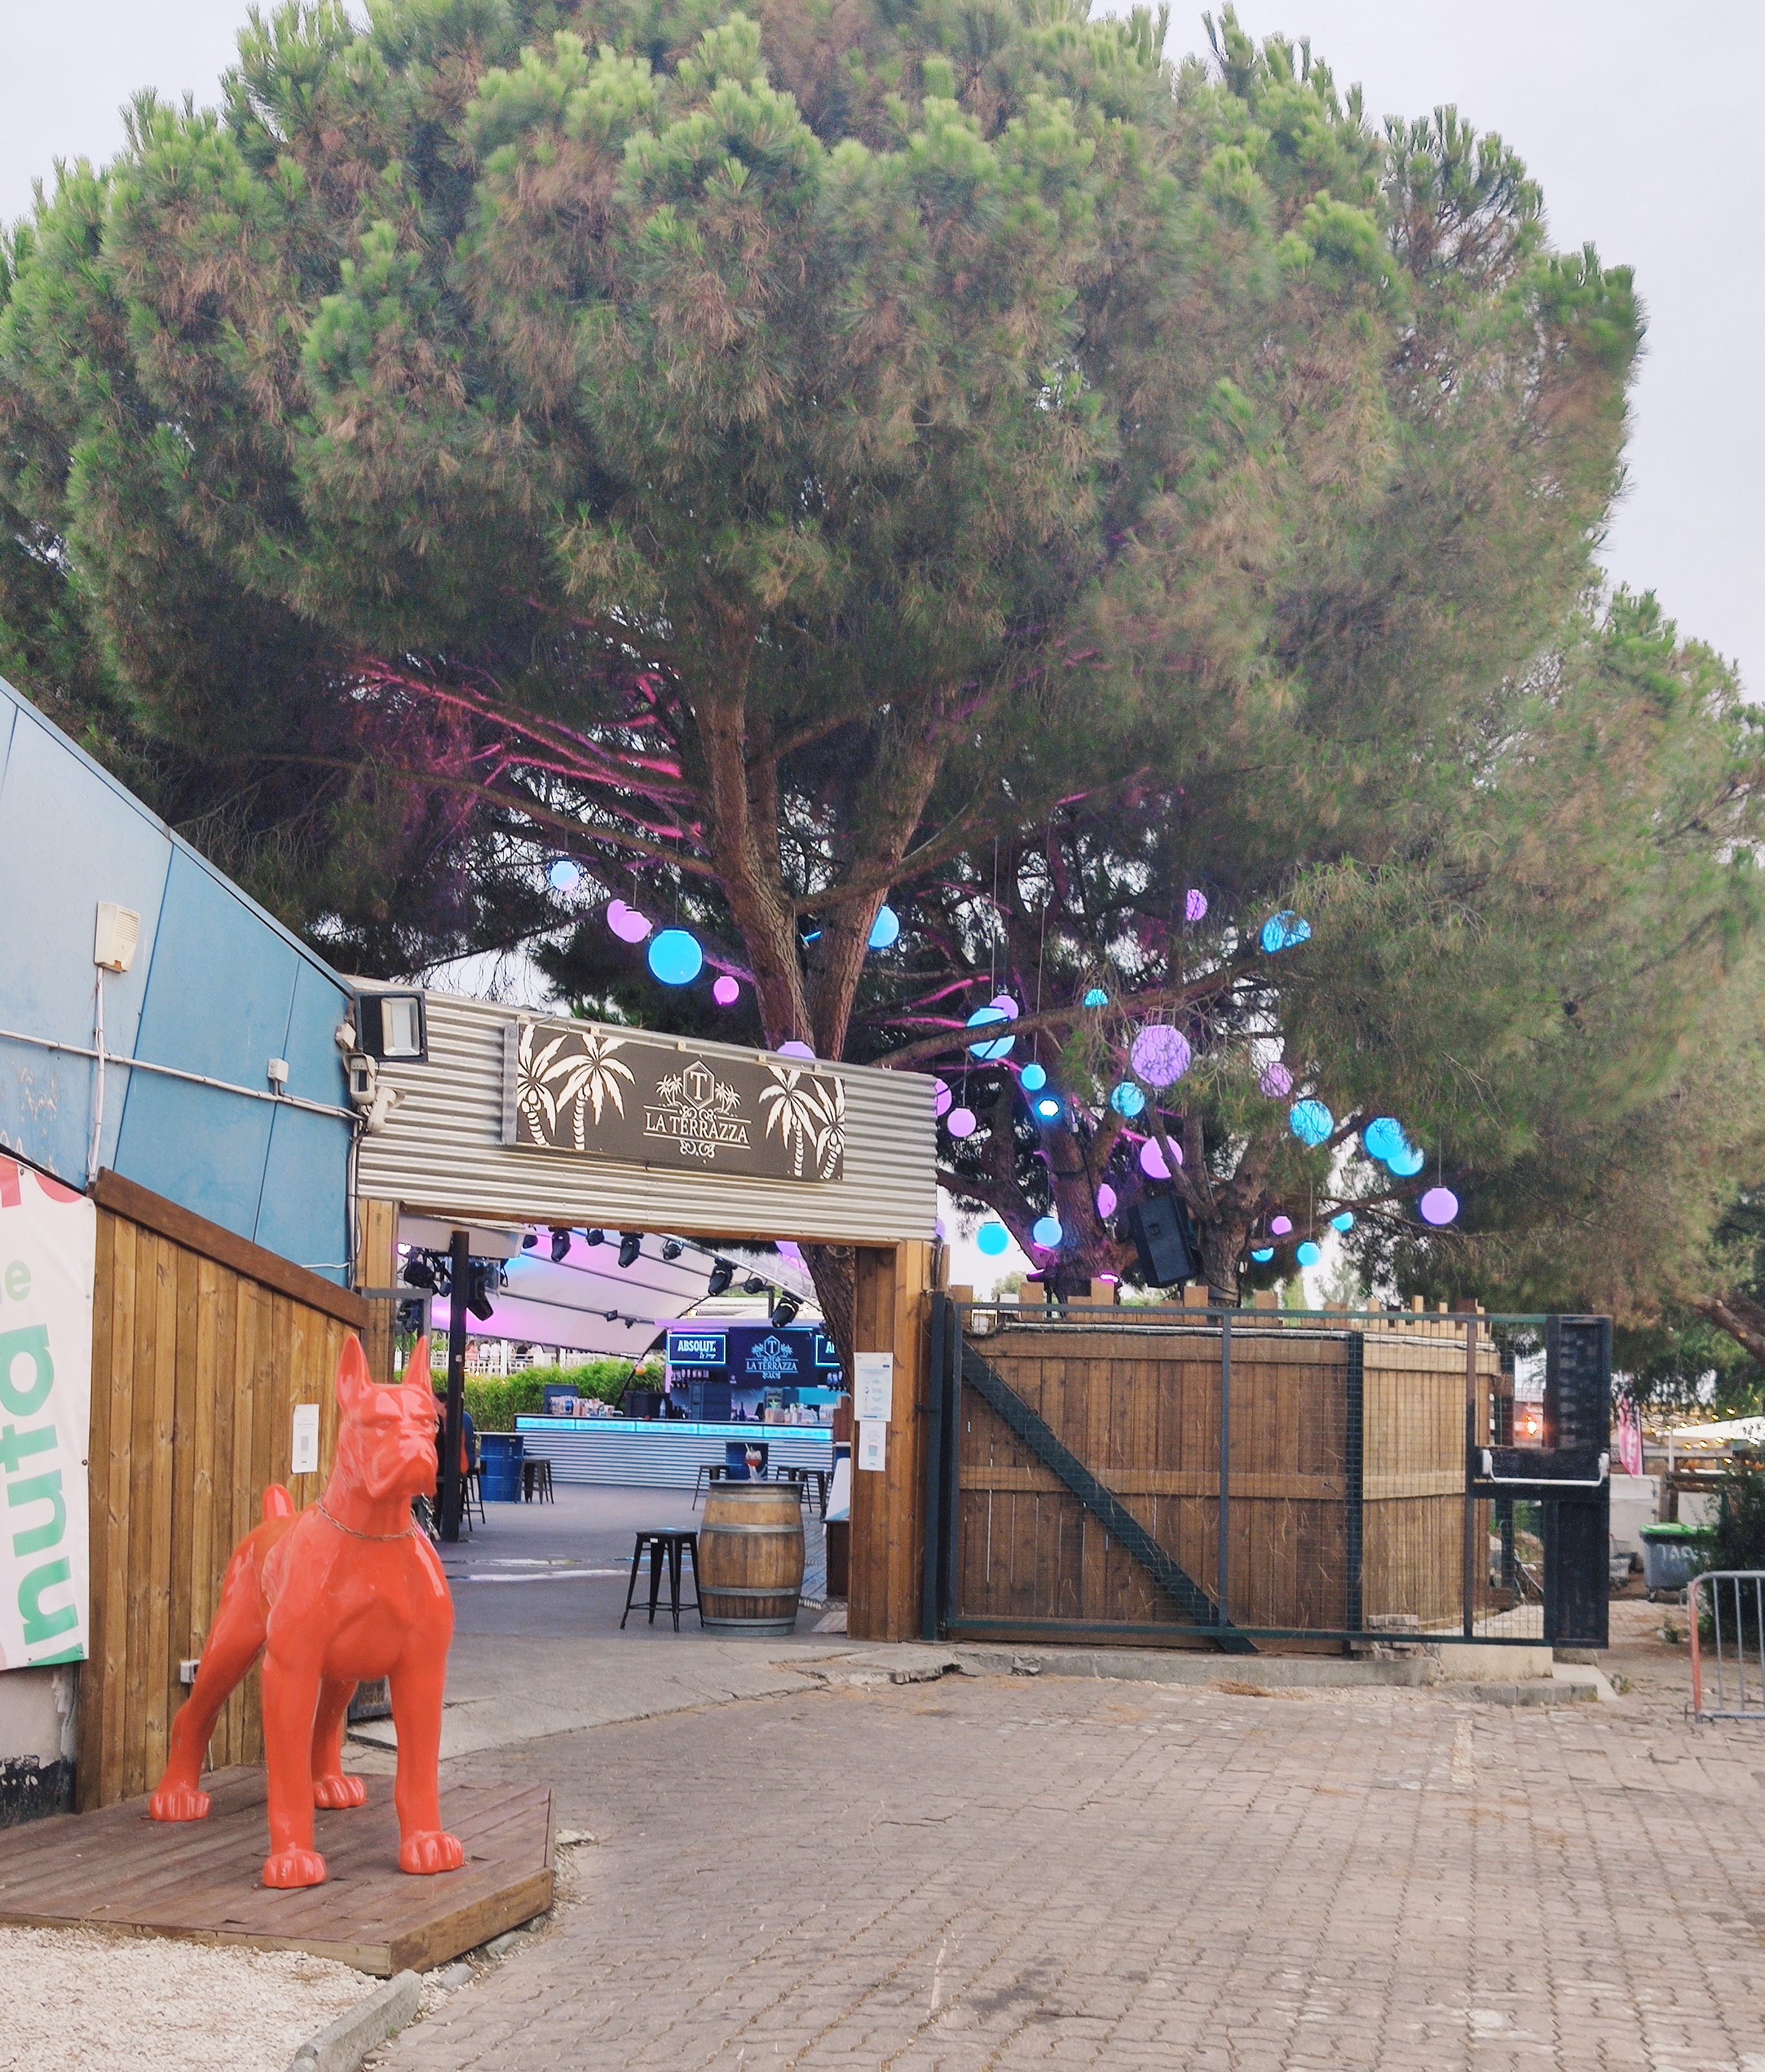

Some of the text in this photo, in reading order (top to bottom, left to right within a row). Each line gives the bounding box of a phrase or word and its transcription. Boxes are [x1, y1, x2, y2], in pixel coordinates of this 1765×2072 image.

[690, 1071, 708, 1101] T
[645, 1112, 749, 1144] LA TERRAZZA
[0, 1259, 32, 1302] e
[767, 1340, 777, 1354] T
[746, 1361, 797, 1371] LA TERRAZZA
[0, 1322, 85, 1667] nuta
